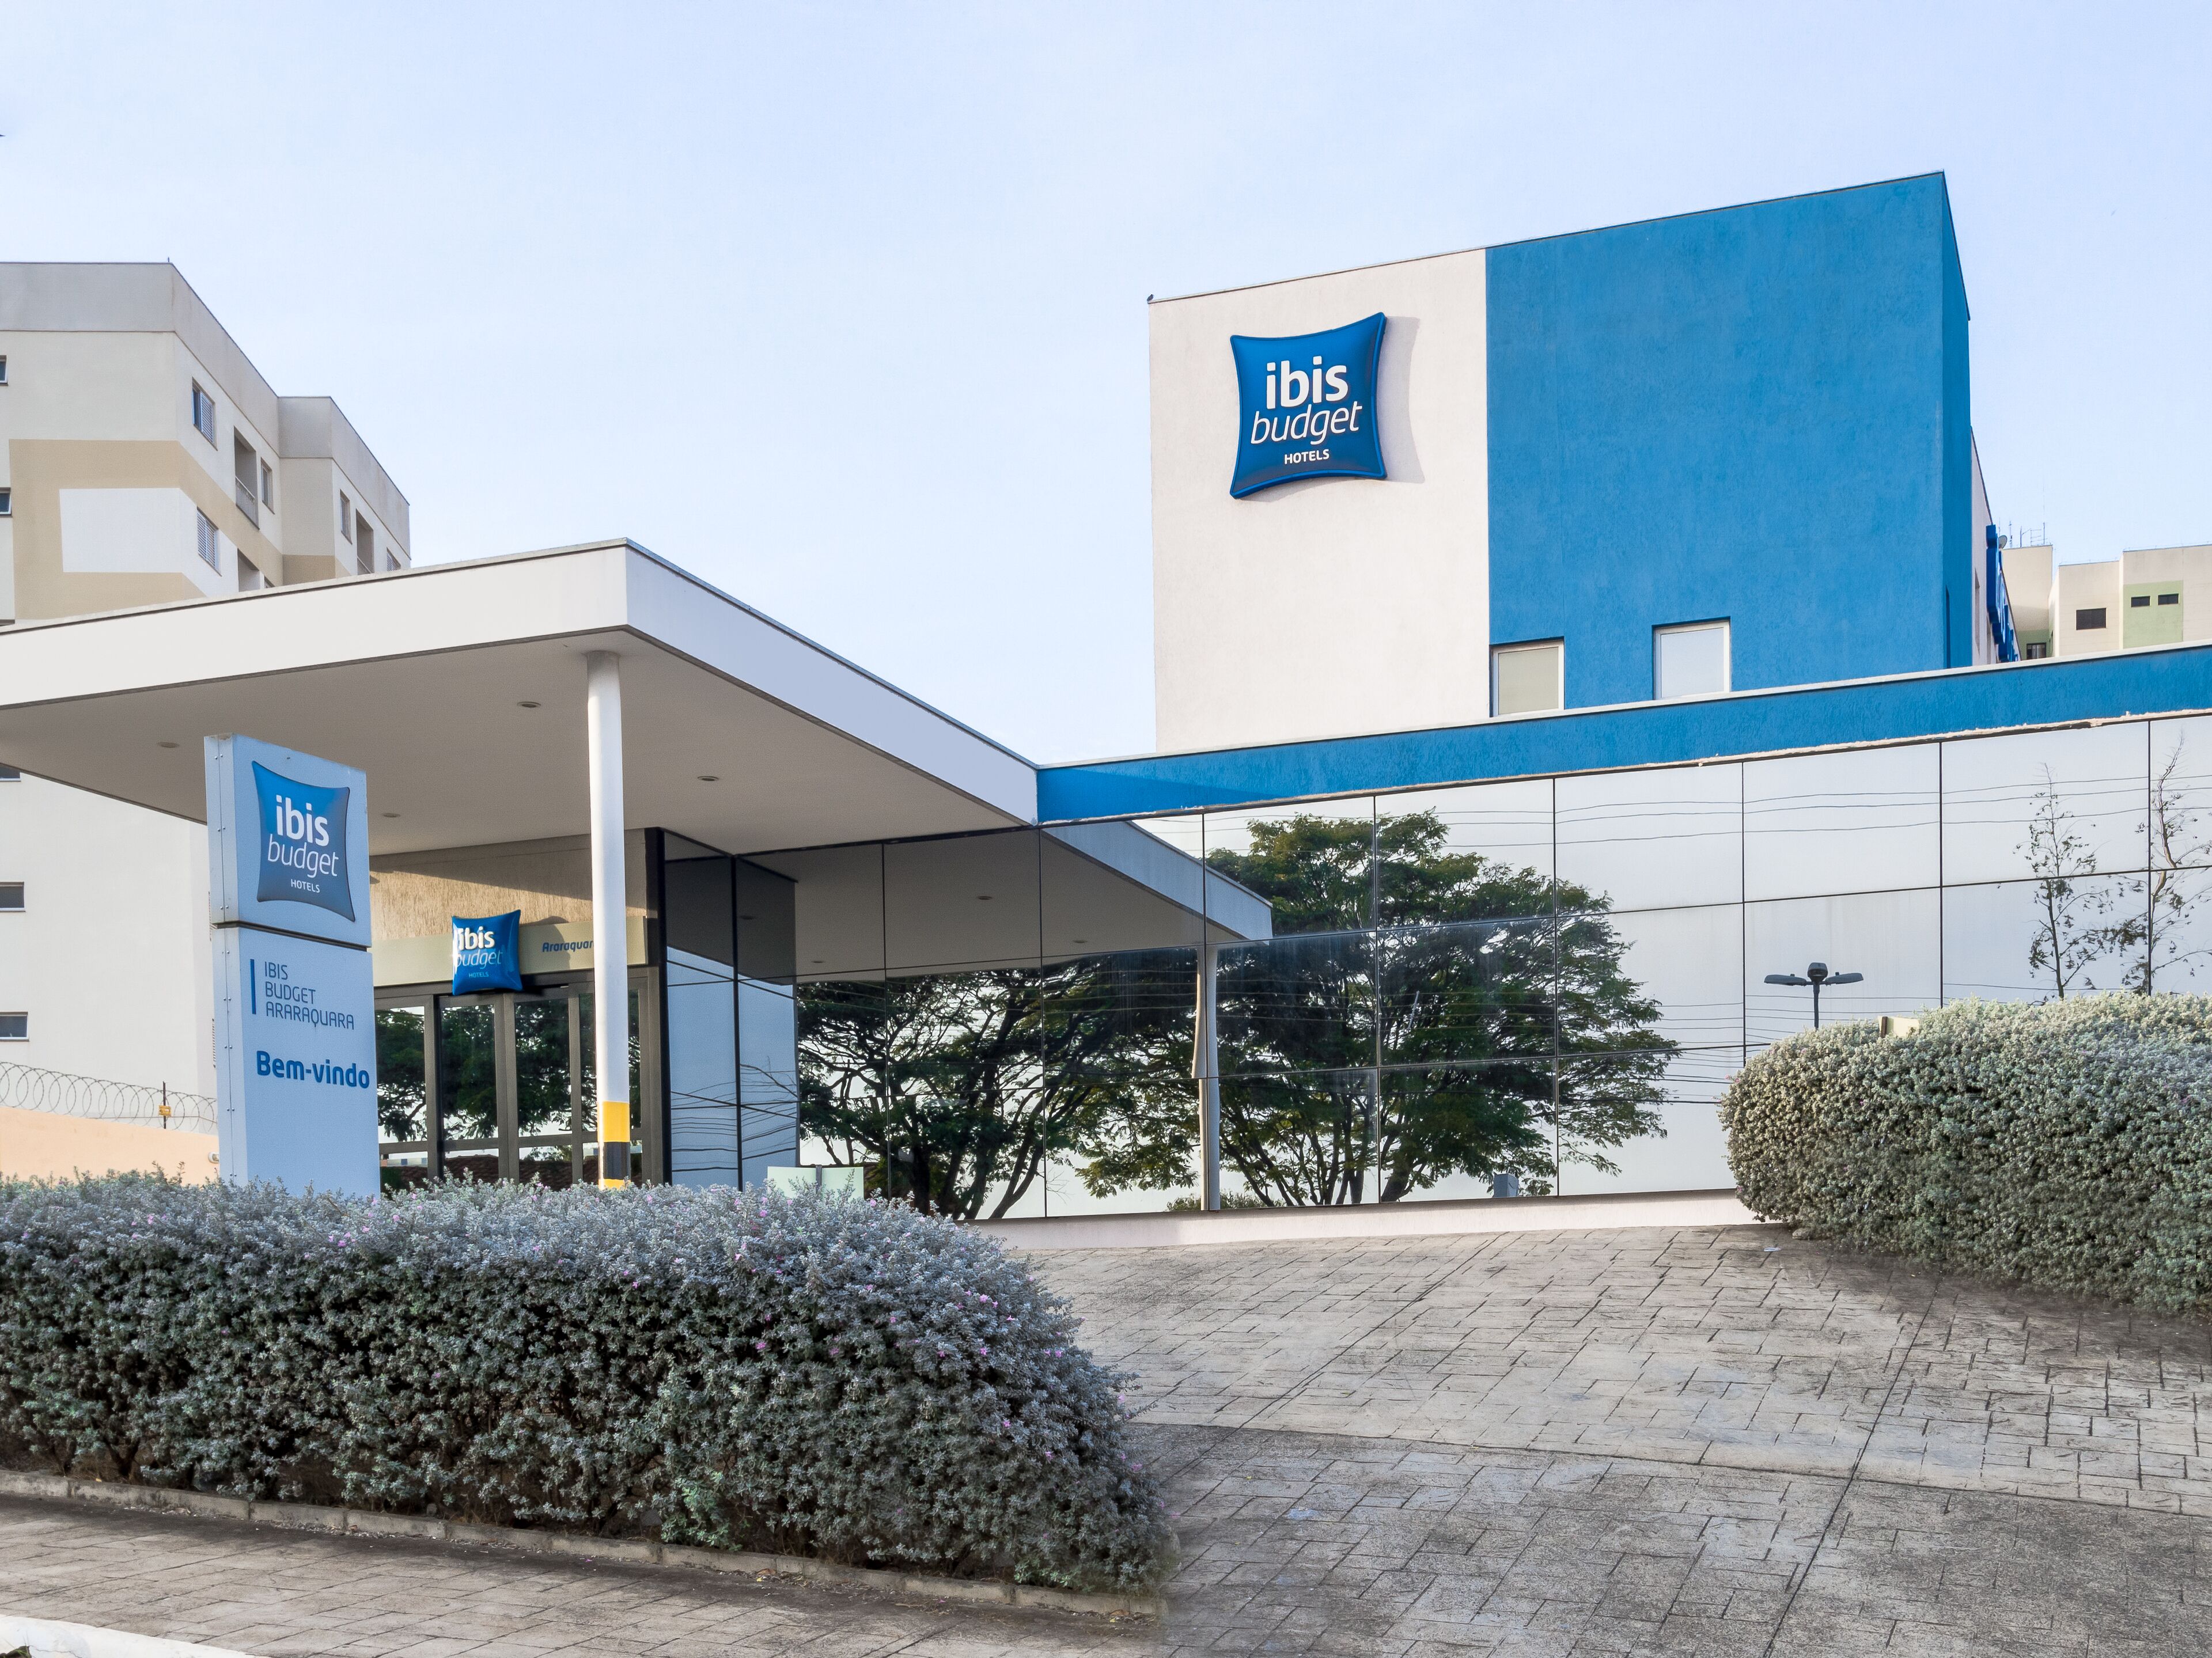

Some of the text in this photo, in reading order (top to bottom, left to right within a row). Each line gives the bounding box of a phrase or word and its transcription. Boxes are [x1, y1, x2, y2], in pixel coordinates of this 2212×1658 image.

[1266, 355, 1349, 409] ibis
[1250, 400, 1363, 445] budget
[1284, 449, 1330, 465] HOTELS
[276, 794, 329, 847] ibis
[267, 833, 339, 878] budget
[290, 878, 320, 893] HOTELS
[458, 925, 495, 950] ibis
[542, 940, 593, 953] Araraquar
[264, 961, 289, 980] IBIS
[265, 981, 316, 1004] BUDGET
[266, 1001, 355, 1030] ARARAQUARA
[256, 1050, 370, 1089] Bem-vindo
